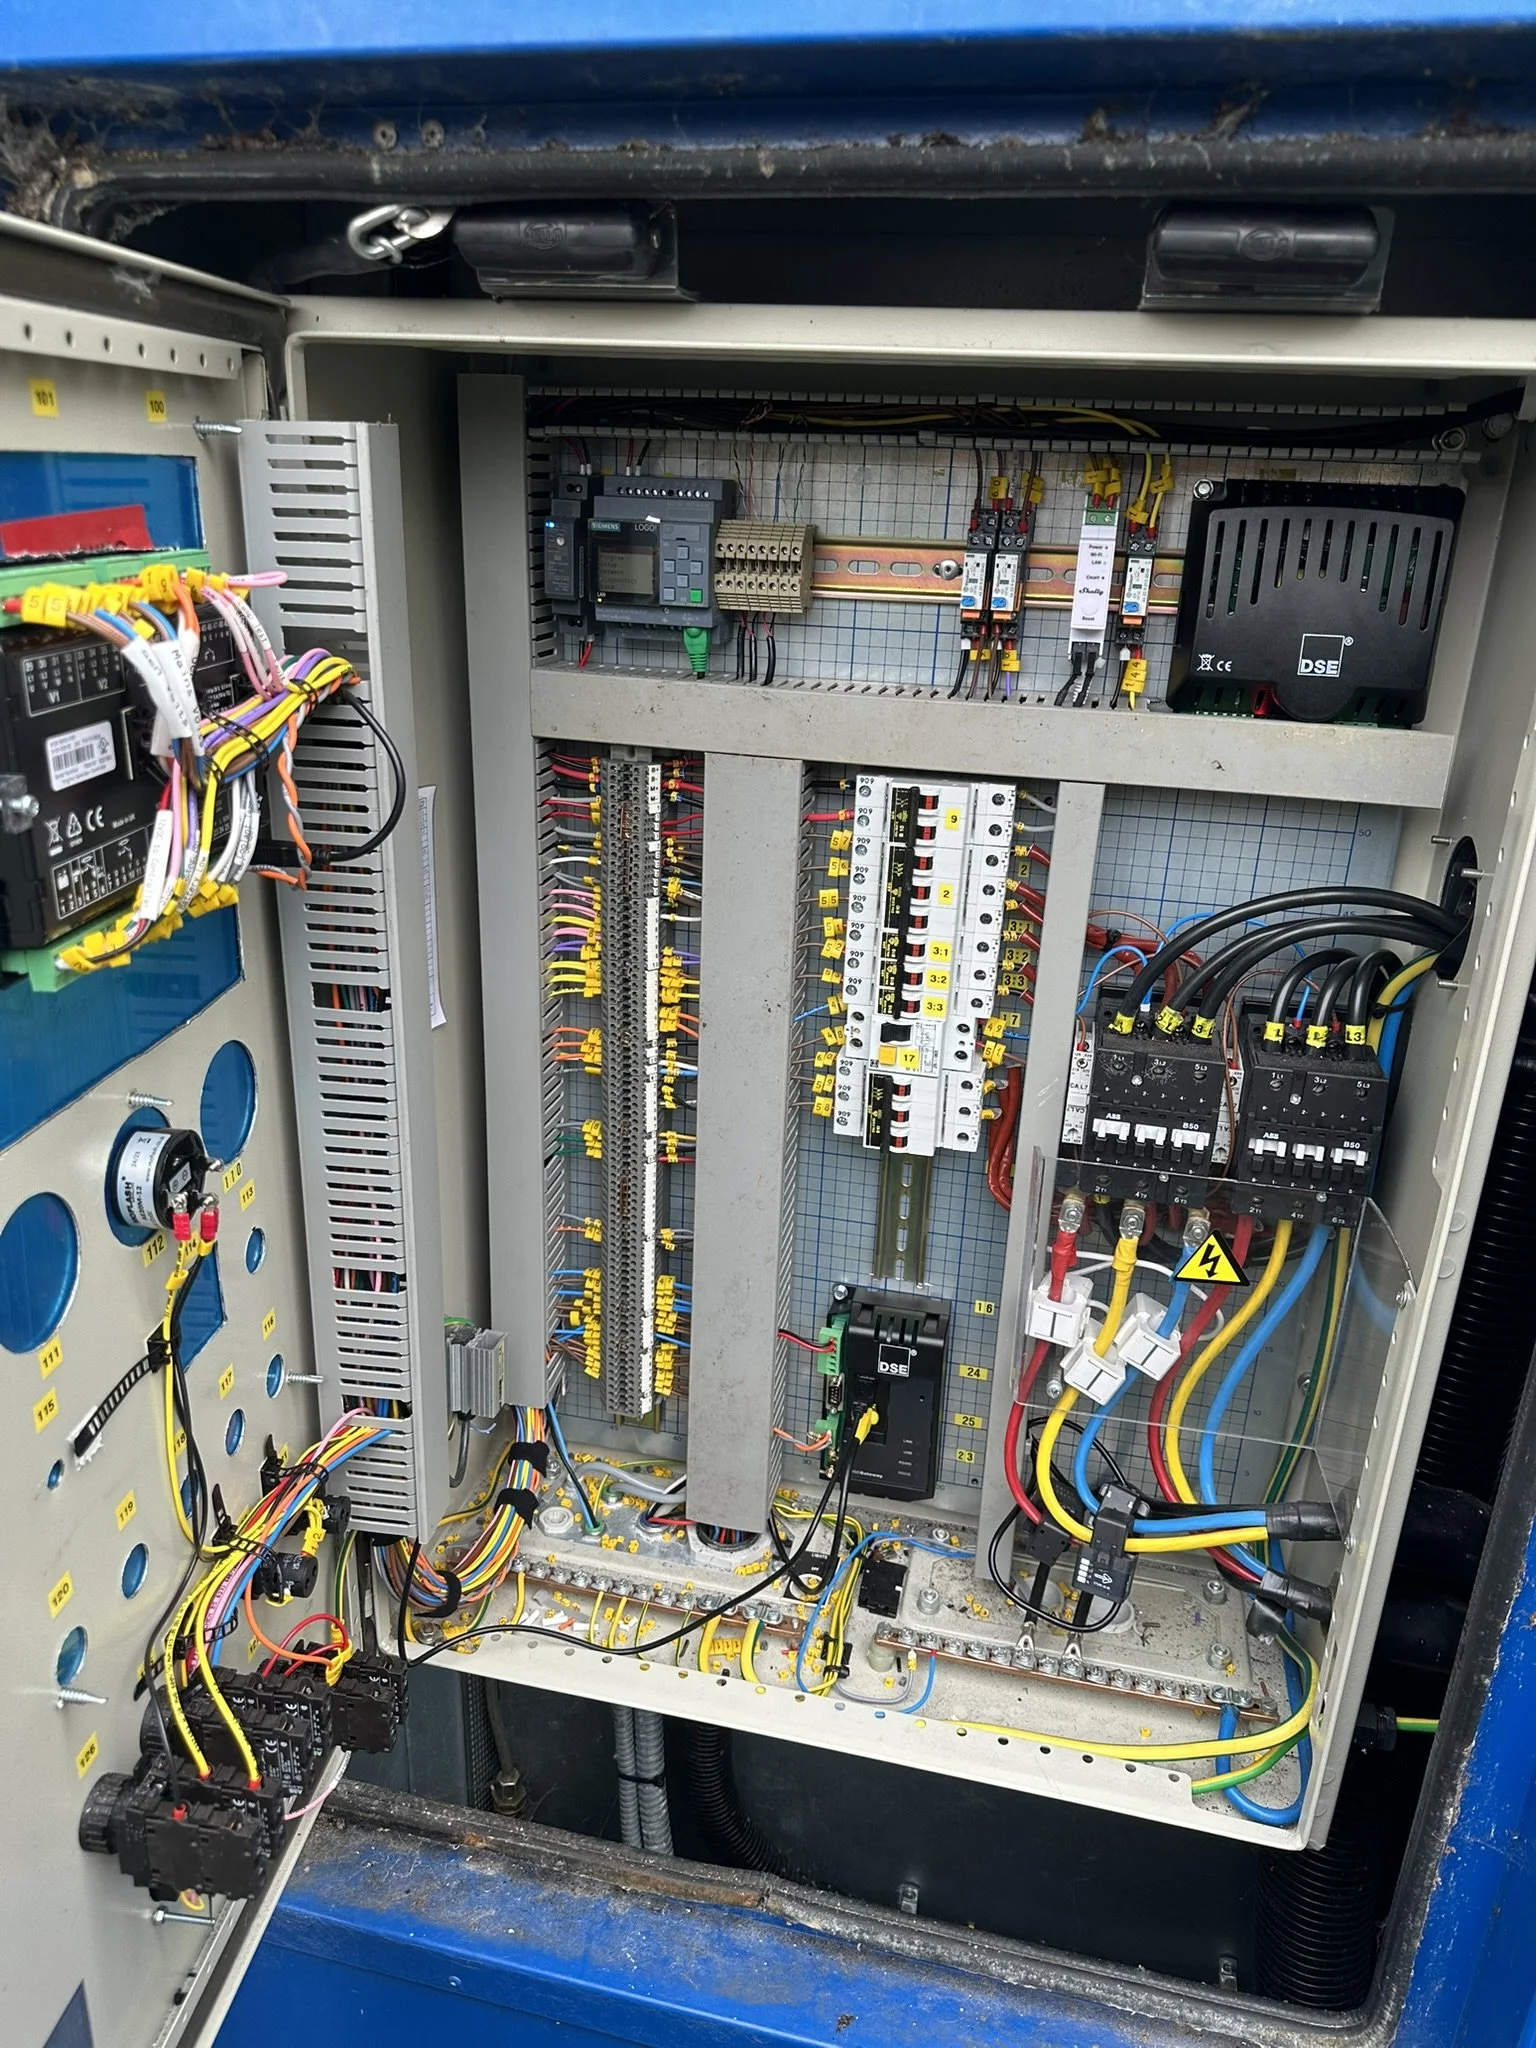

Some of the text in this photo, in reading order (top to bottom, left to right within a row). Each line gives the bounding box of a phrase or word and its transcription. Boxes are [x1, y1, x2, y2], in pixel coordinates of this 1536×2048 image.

[35, 390, 55, 407] 101
[150, 400, 165, 414] 100
[591, 522, 619, 530] SIEMENS
[1079, 587, 1104, 596] Shelly
[1216, 660, 1233, 672] CE
[1300, 657, 1339, 674] DSE
[172, 649, 192, 697] Mains
[98, 678, 108, 690] V2
[48, 690, 60, 703] V1
[950, 815, 958, 824] 9
[1358, 828, 1371, 837] 50
[832, 836, 849, 846] 57
[832, 861, 847, 870] 56
[1020, 864, 1028, 875] 2
[943, 890, 950, 898] 2
[821, 895, 837, 905] 55
[850, 922, 865, 930] 909
[1010, 921, 1031, 932] 3:1
[826, 943, 842, 952] 52
[932, 946, 949, 957] 3:1
[1007, 949, 1028, 962] 3:2
[930, 974, 947, 984] 3:2
[1004, 974, 1025, 987] 3:3
[926, 1001, 943, 1012] 3:3
[1003, 1013, 1018, 1026] 17
[987, 1022, 1002, 1033] 49
[827, 1030, 843, 1039] 48
[1346, 1031, 1362, 1042] L3
[817, 1053, 833, 1061] 60
[985, 1047, 1001, 1056] 51
[904, 1054, 915, 1063] 17
[816, 1079, 832, 1089] 59
[815, 1102, 830, 1111] 58
[1182, 1122, 1199, 1130] B50
[1263, 1132, 1279, 1140] ABB
[1343, 1141, 1361, 1149] B50
[223, 1163, 242, 1189] 110
[242, 1186, 255, 1203] 113
[147, 1234, 164, 1259] 112
[184, 1235, 197, 1254] 114
[977, 1304, 993, 1314] 16
[263, 1318, 274, 1333] 116
[42, 1347, 60, 1369] 111
[880, 1361, 908, 1375] DSE
[967, 1367, 981, 1377] 24
[221, 1372, 232, 1391] 117
[37, 1401, 55, 1422] 115
[962, 1416, 976, 1426] 25
[957, 1451, 974, 1461] 23
[119, 1501, 134, 1522] 119
[53, 1583, 69, 1606] 120
[80, 1743, 96, 1767] 126
